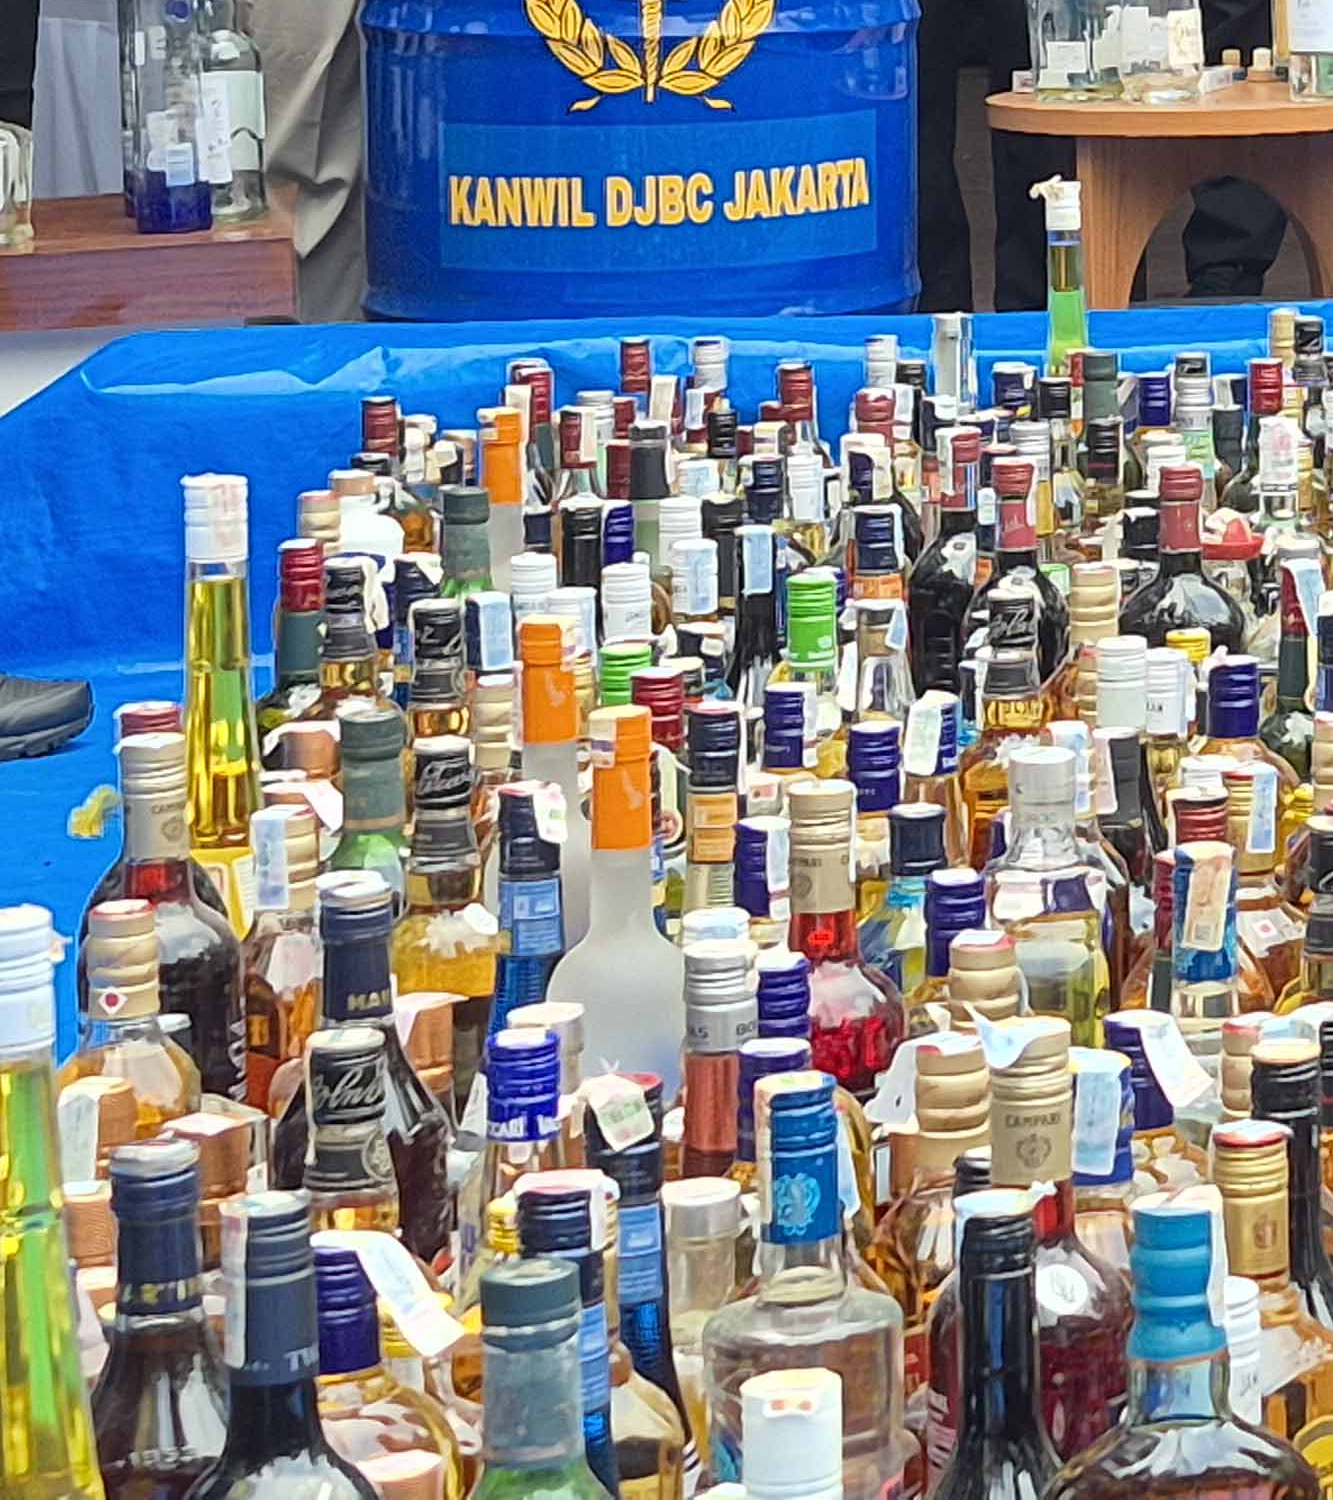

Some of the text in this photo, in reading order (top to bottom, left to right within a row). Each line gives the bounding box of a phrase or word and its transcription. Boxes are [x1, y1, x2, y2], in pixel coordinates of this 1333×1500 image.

[449, 159, 870, 228] KANWIL DJBC JAKARTA
